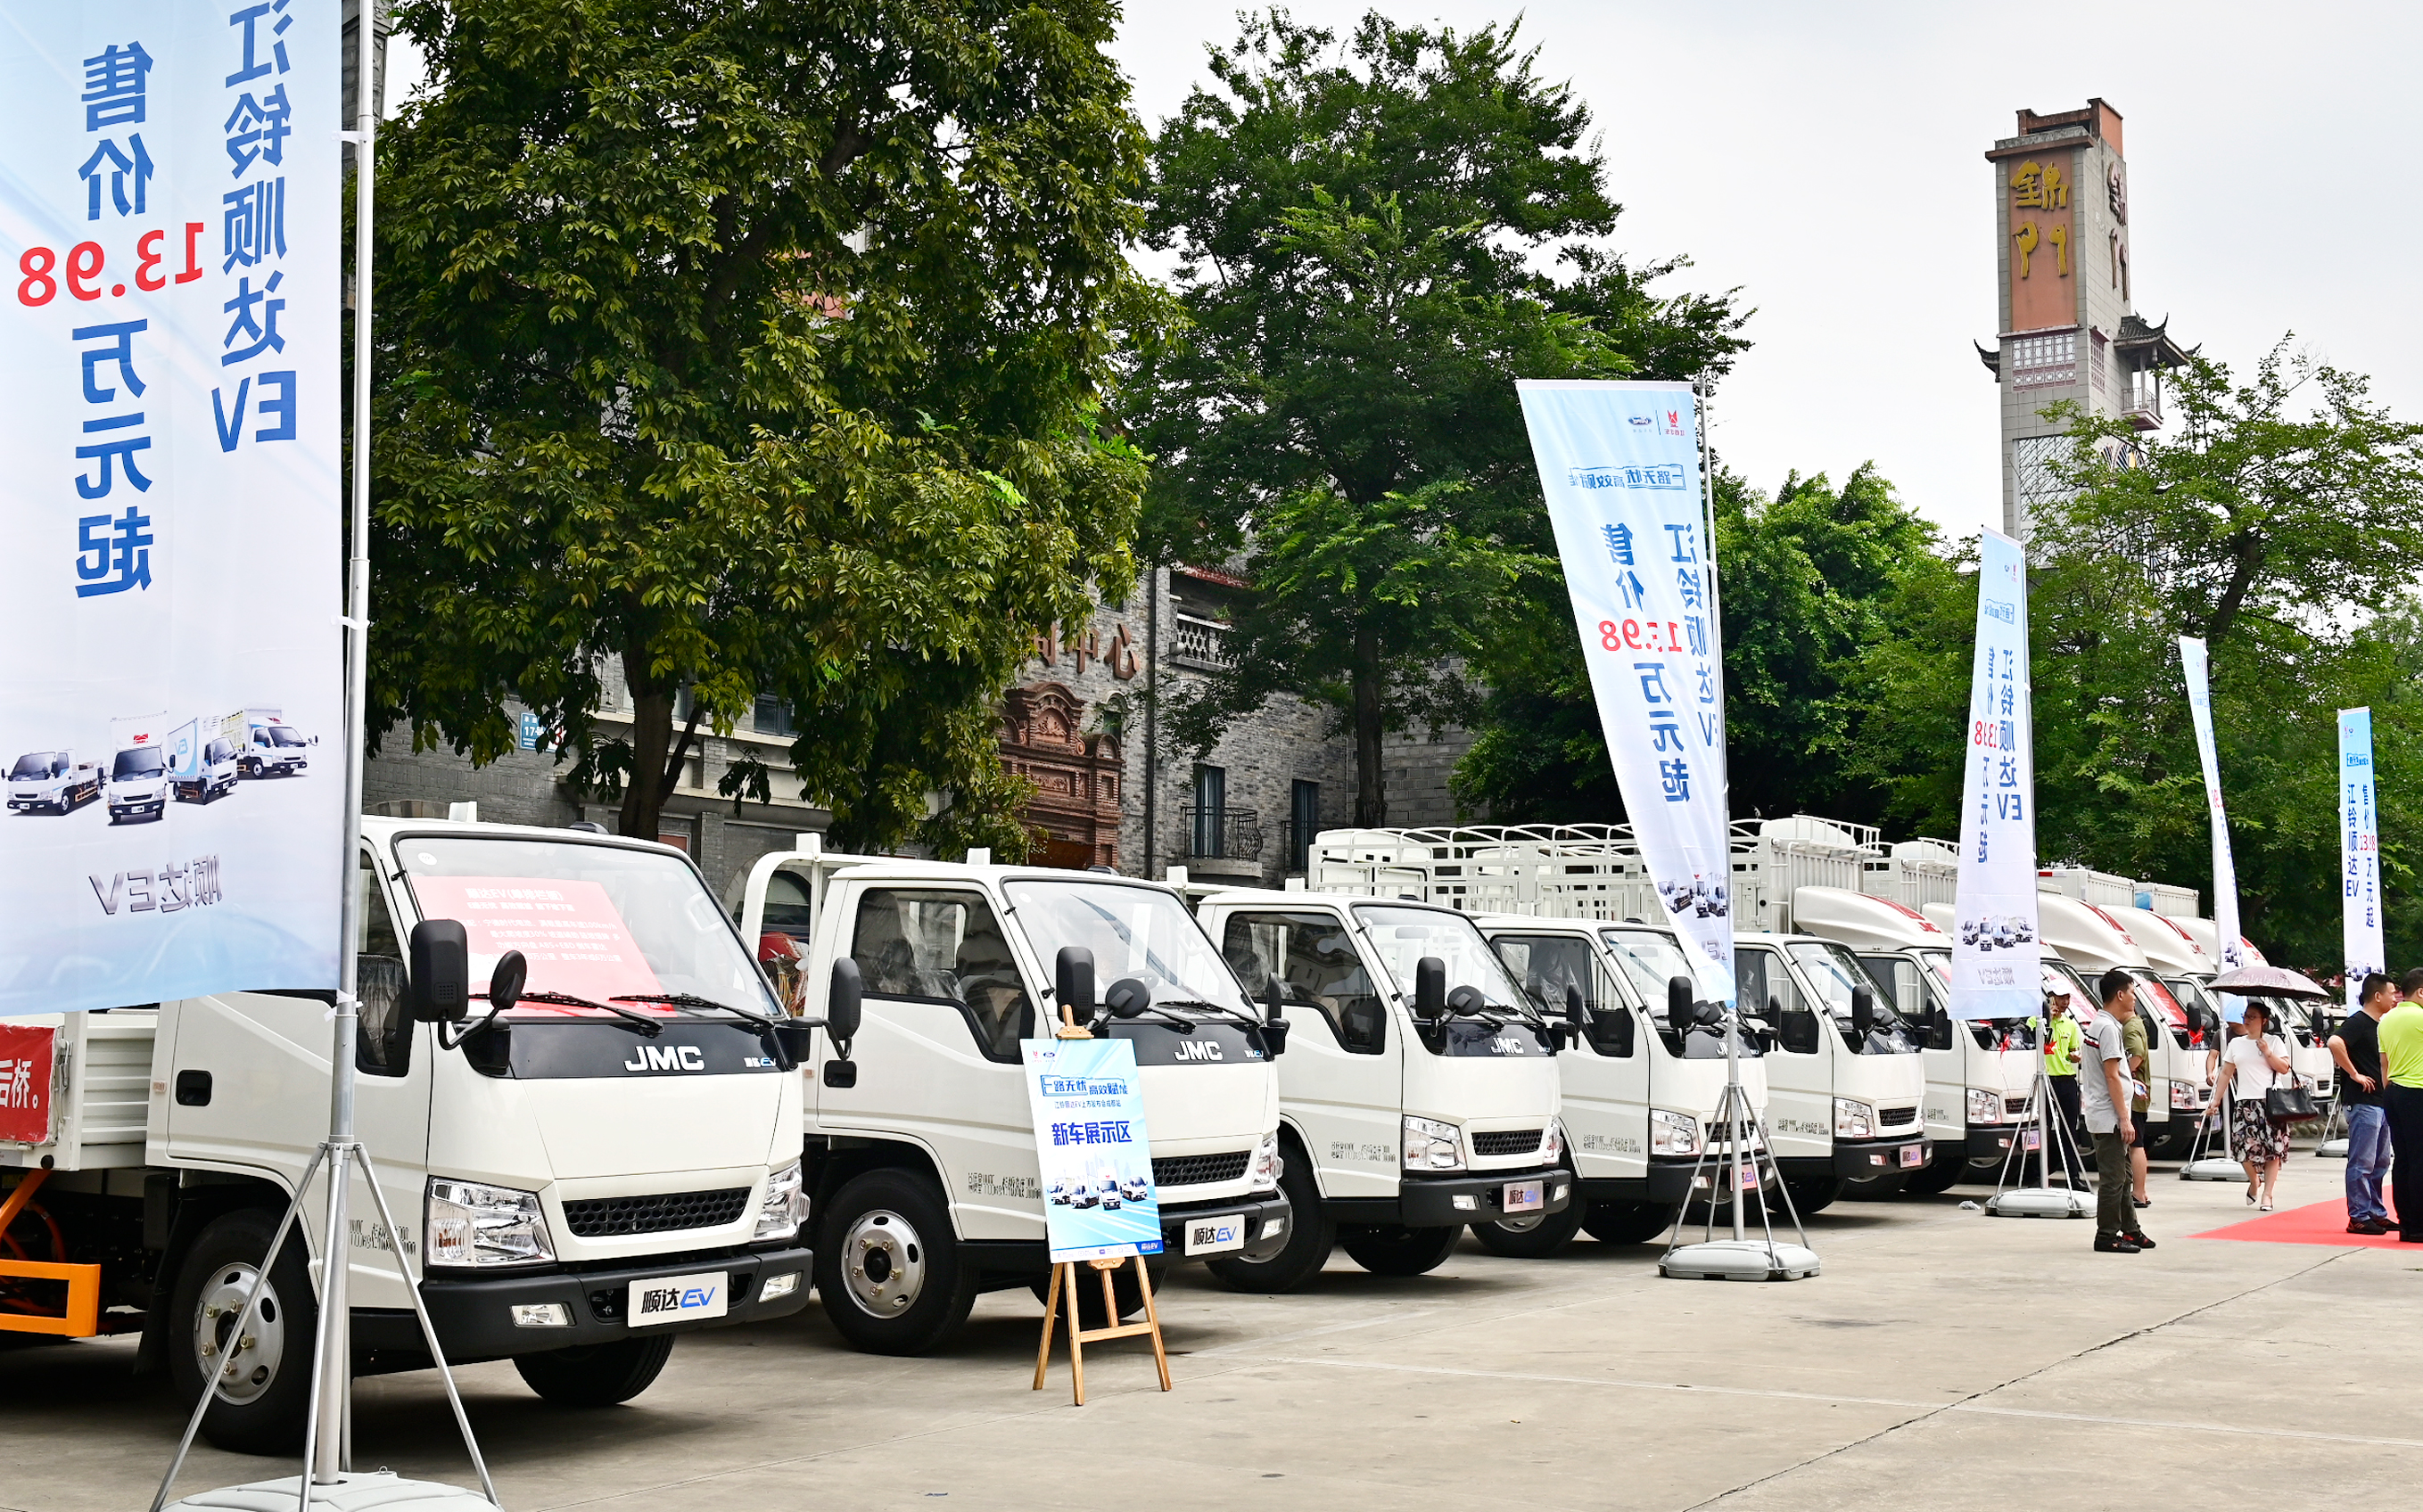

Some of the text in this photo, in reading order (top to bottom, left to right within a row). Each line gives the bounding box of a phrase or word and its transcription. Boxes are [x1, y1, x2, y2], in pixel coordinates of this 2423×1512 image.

[1174, 1041, 1223, 1061] JMC
[1490, 1038, 1524, 1055] JMC
[624, 1046, 705, 1071] JMC
[1052, 1121, 1133, 1146] 新车展示区
[1193, 1226, 1237, 1246] 顺达EV
[640, 1286, 716, 1314] 顺达EV
